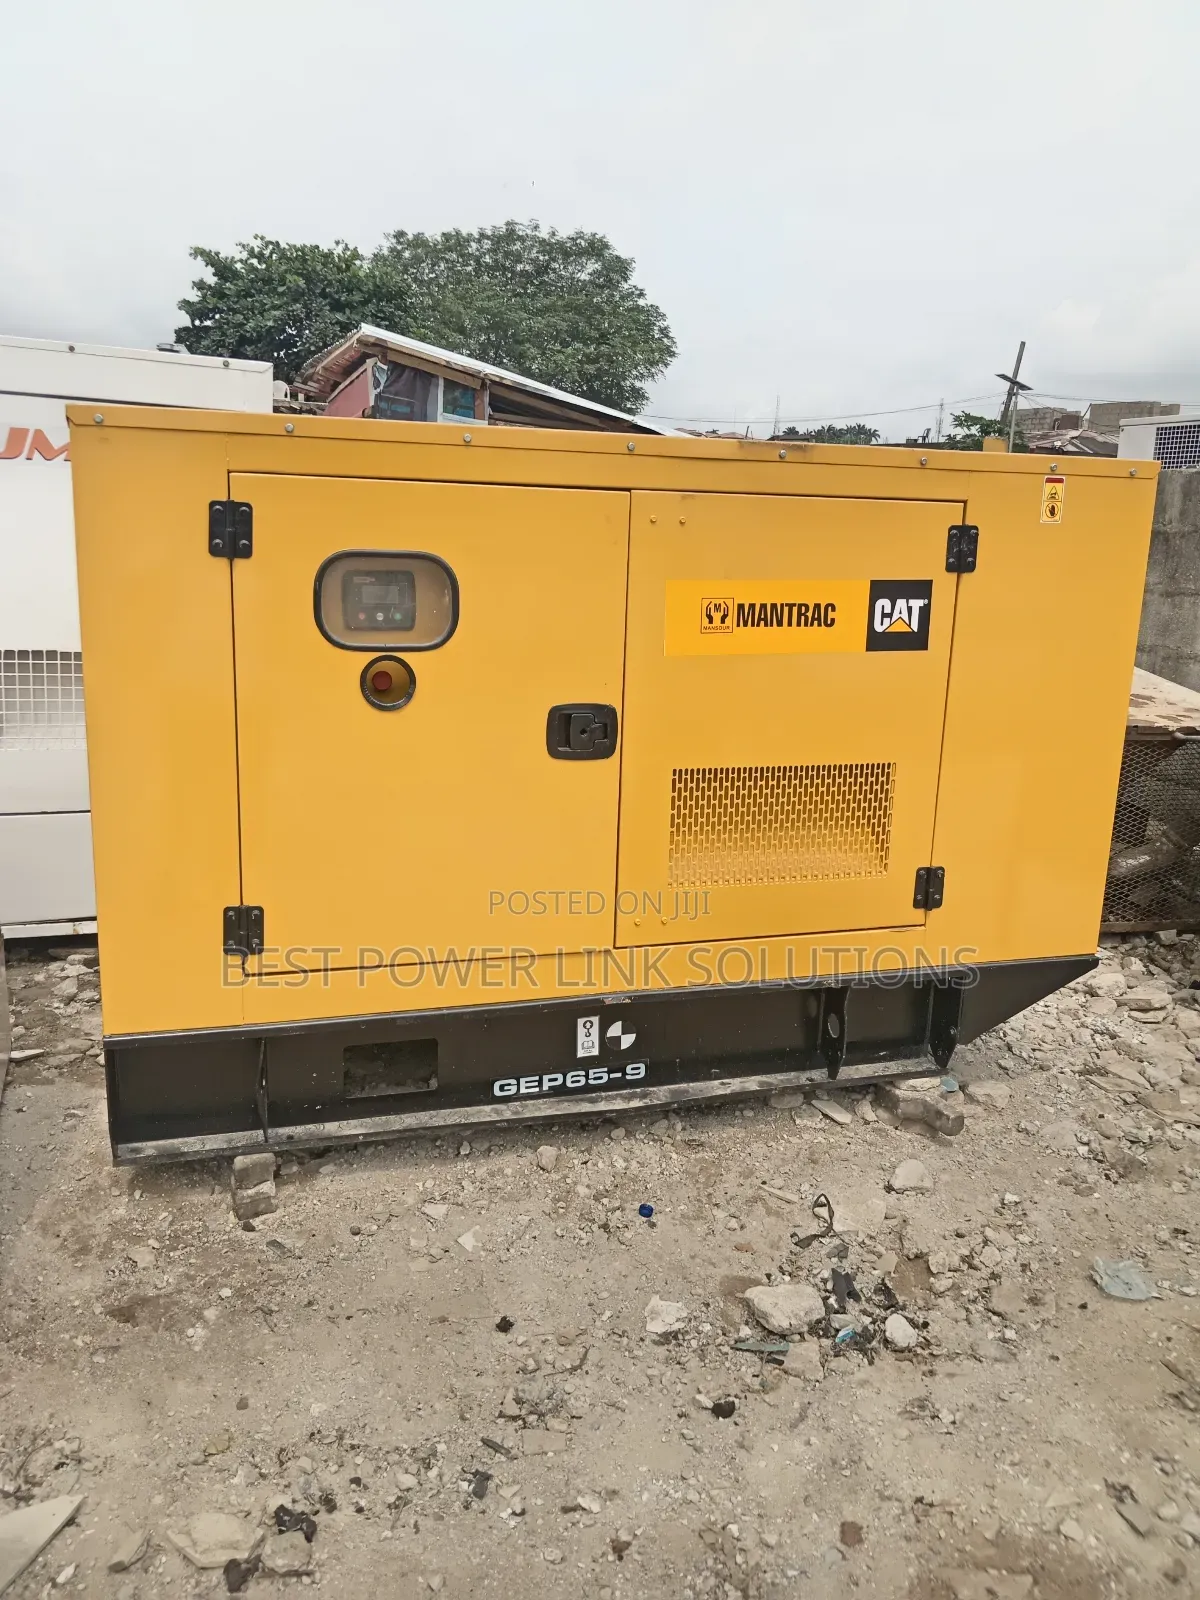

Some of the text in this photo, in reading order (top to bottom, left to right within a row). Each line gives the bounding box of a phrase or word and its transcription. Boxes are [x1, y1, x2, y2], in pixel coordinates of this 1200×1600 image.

[713, 603, 722, 613] M
[736, 603, 836, 628] MANTRAC
[873, 598, 924, 633] CAT
[493, 1062, 647, 1098] GEP65-9
